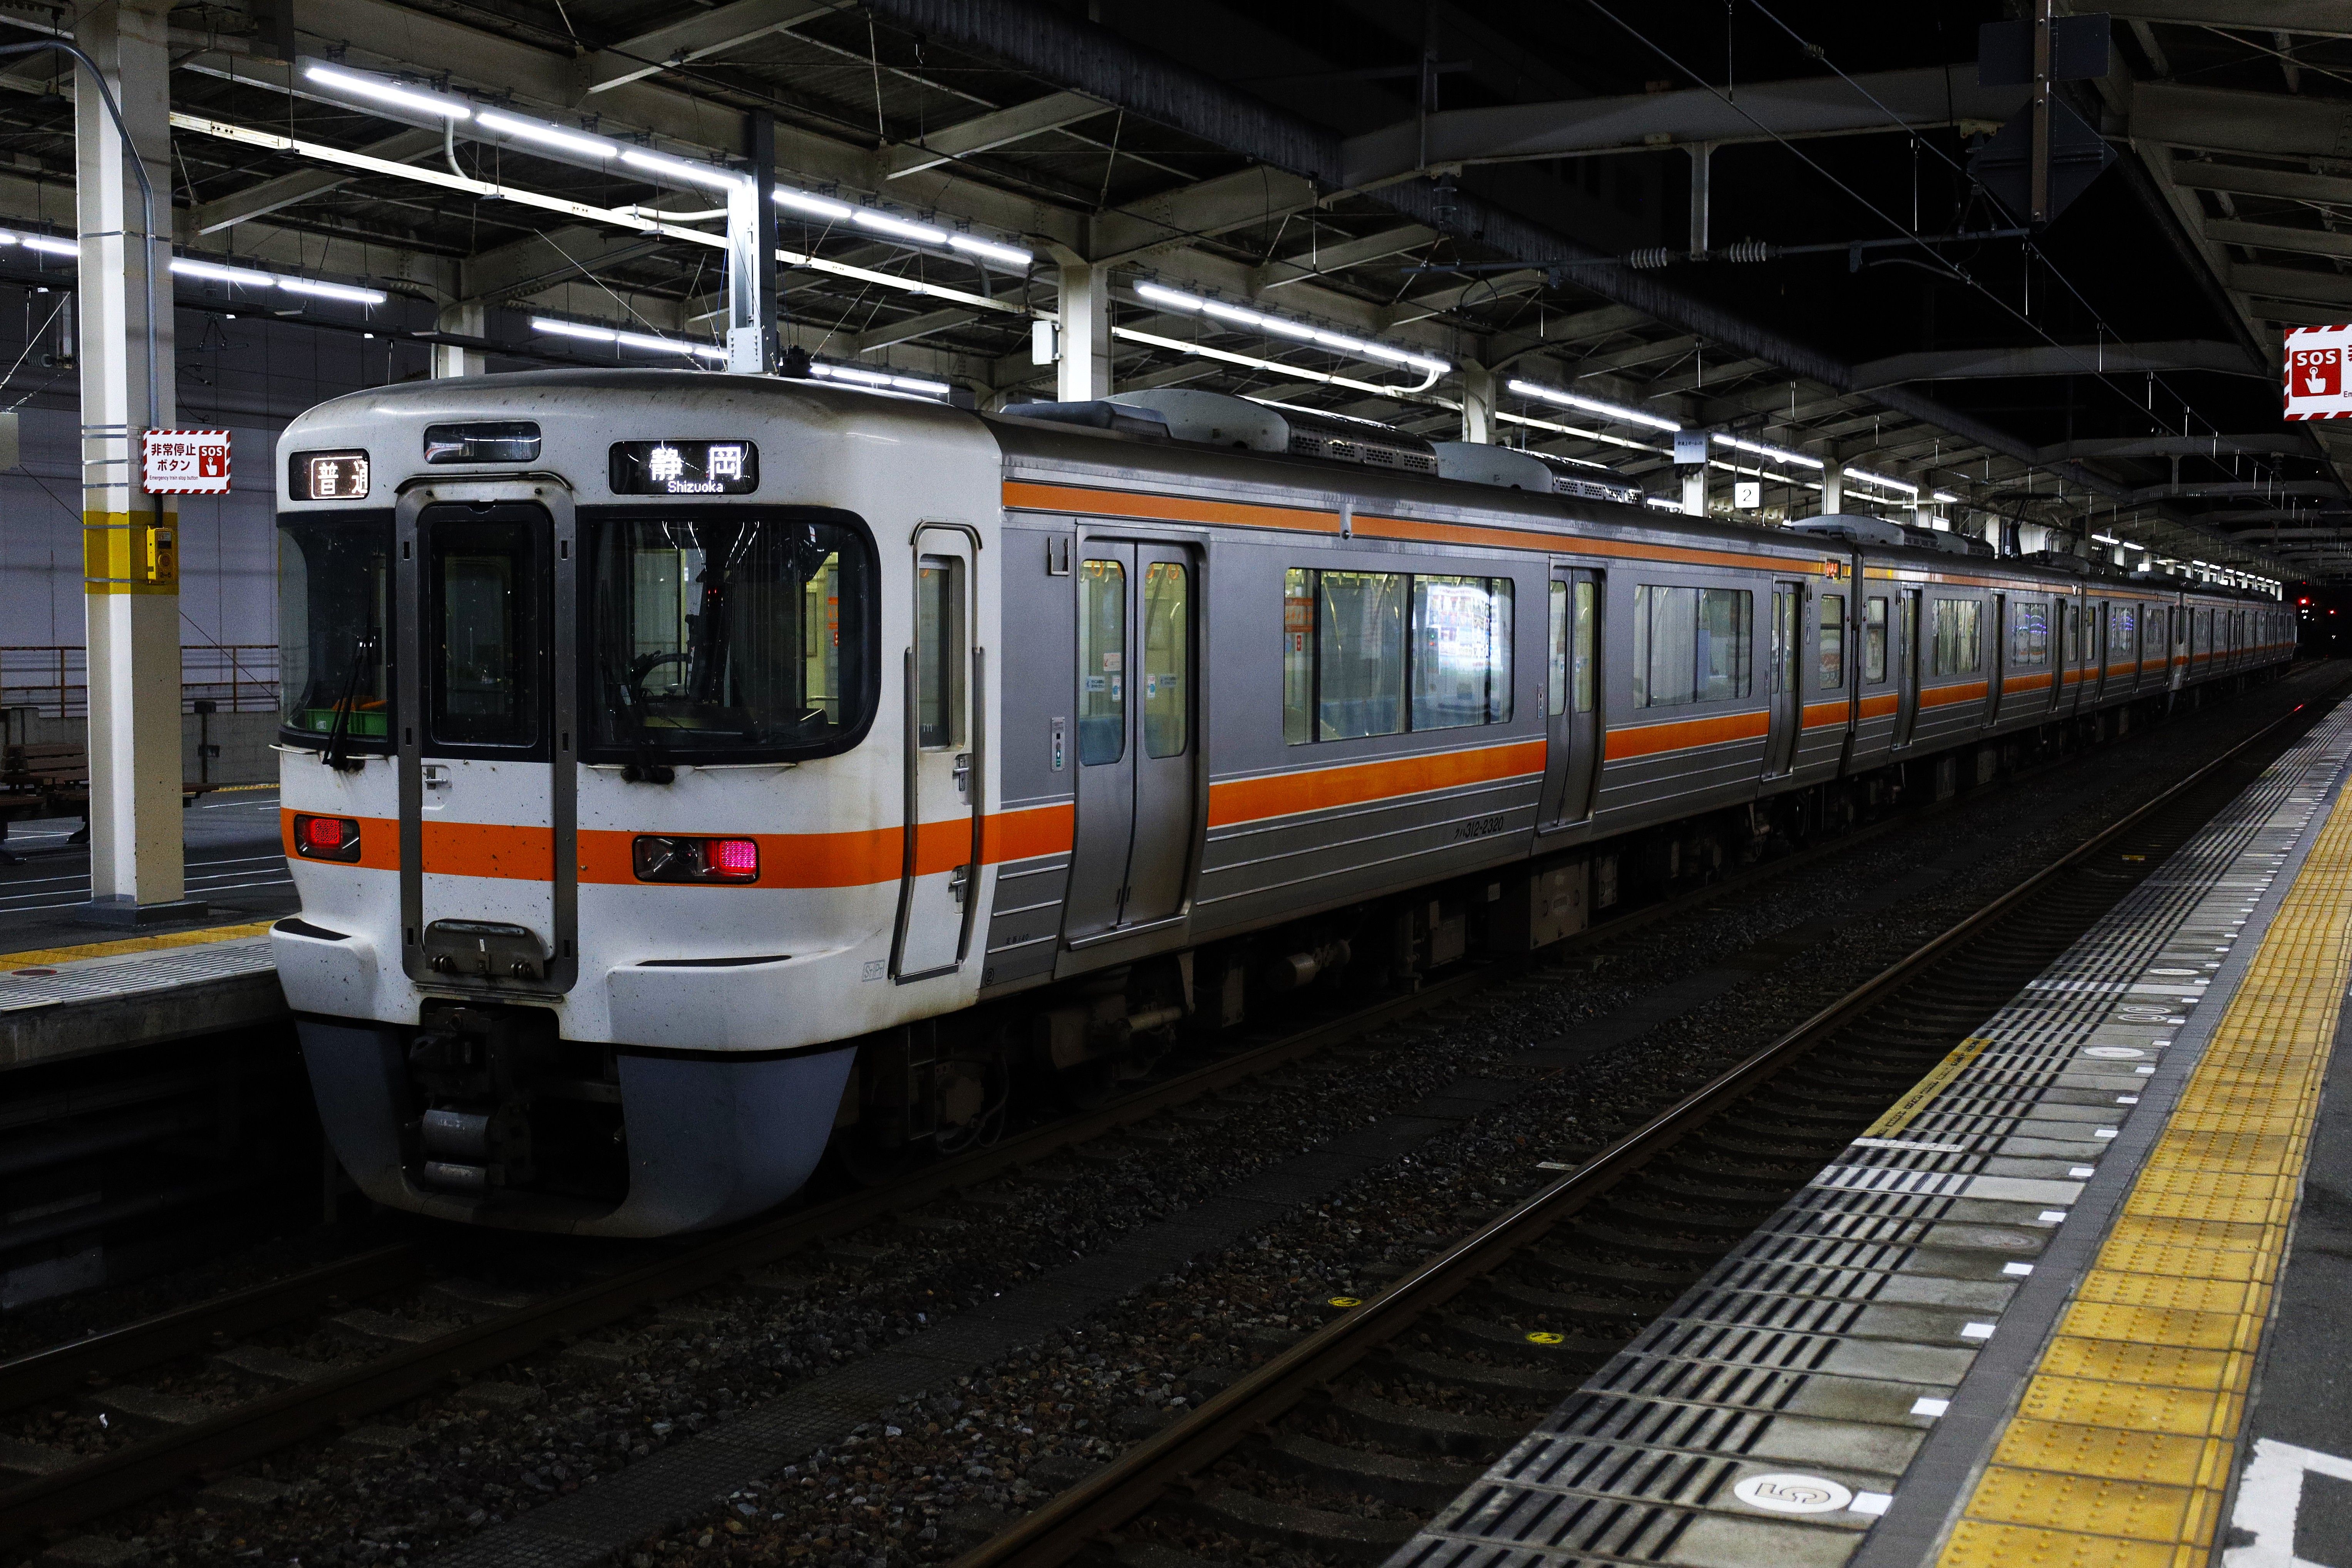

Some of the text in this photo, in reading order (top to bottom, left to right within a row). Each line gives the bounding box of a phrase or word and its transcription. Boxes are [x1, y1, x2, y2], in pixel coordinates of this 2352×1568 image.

[2297, 350, 2336, 366] SOS
[151, 443, 196, 456] 非常停止
[201, 447, 223, 457] SOS
[157, 459, 190, 471] ボタン
[649, 447, 741, 481] 静岡
[667, 480, 724, 493] Shizuoka
[1743, 489, 1752, 502] 2
[1754, 1483, 1831, 1504] 5
